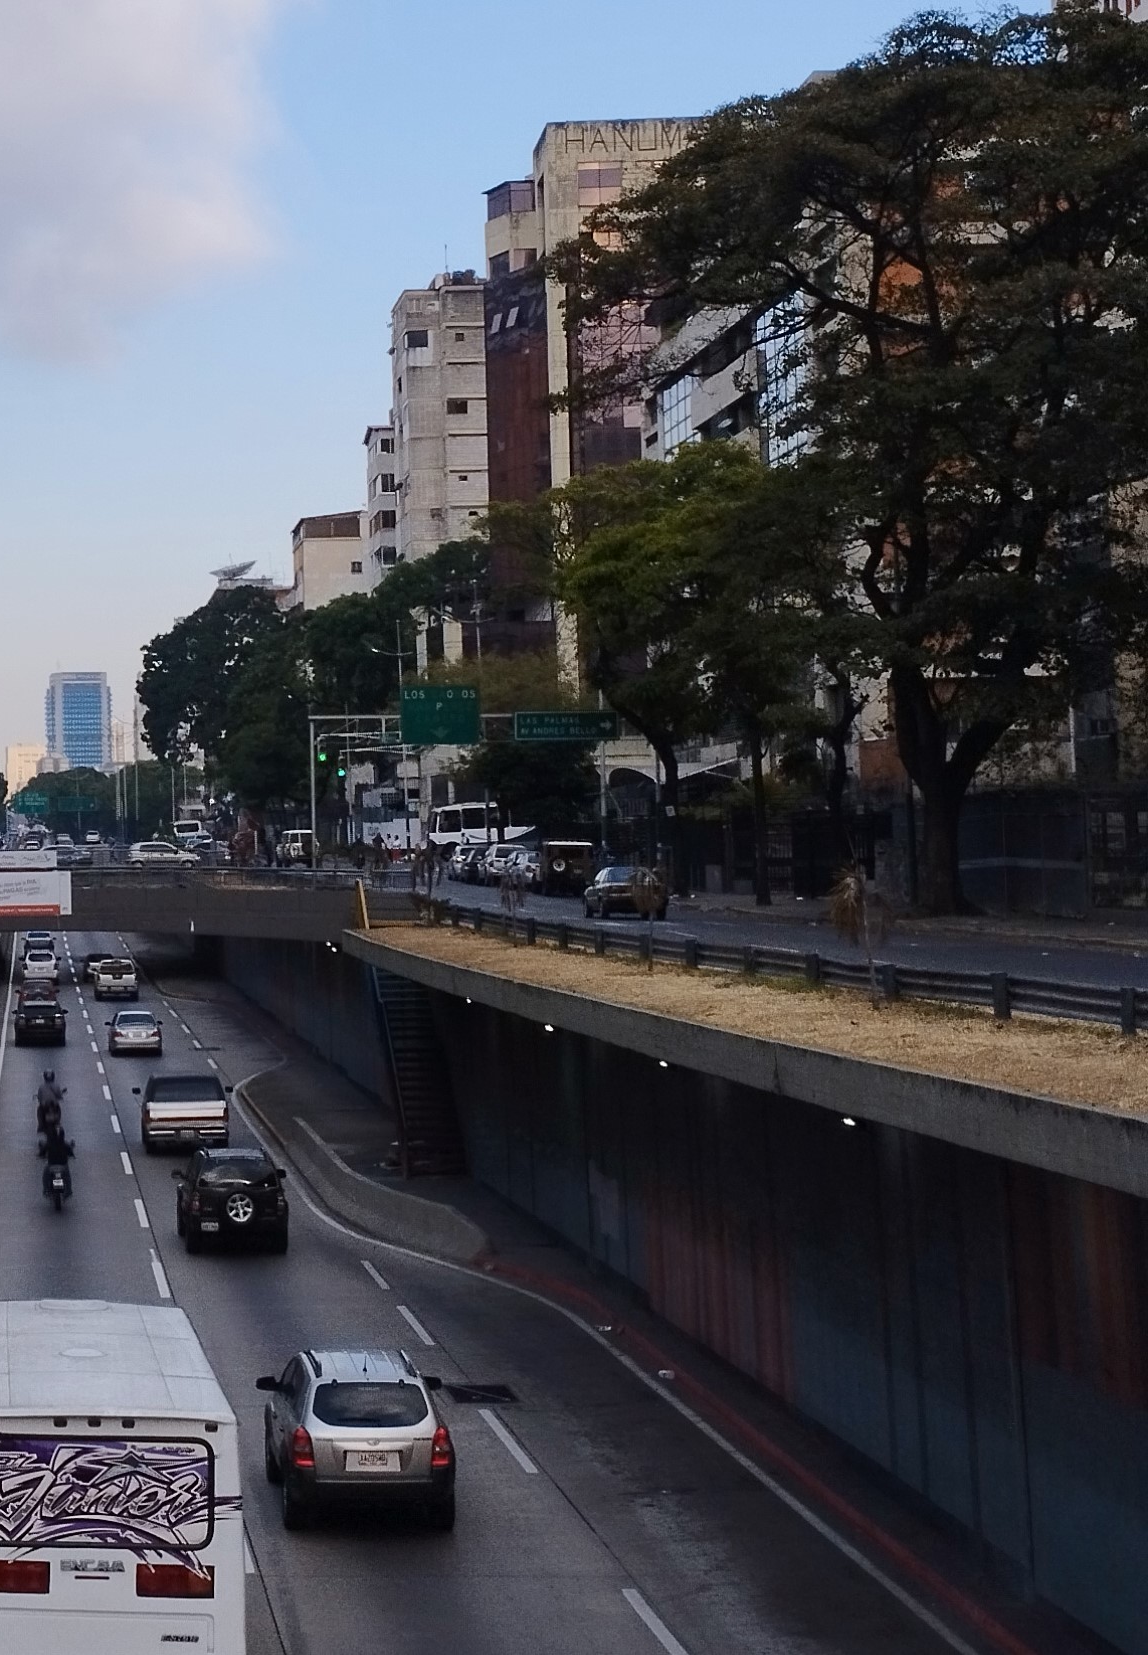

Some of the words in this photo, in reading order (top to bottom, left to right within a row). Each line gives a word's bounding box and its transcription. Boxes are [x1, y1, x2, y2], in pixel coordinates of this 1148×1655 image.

[404, 689, 425, 699] LOS
[519, 716, 538, 725] LAS
[544, 716, 580, 725] PALMAS
